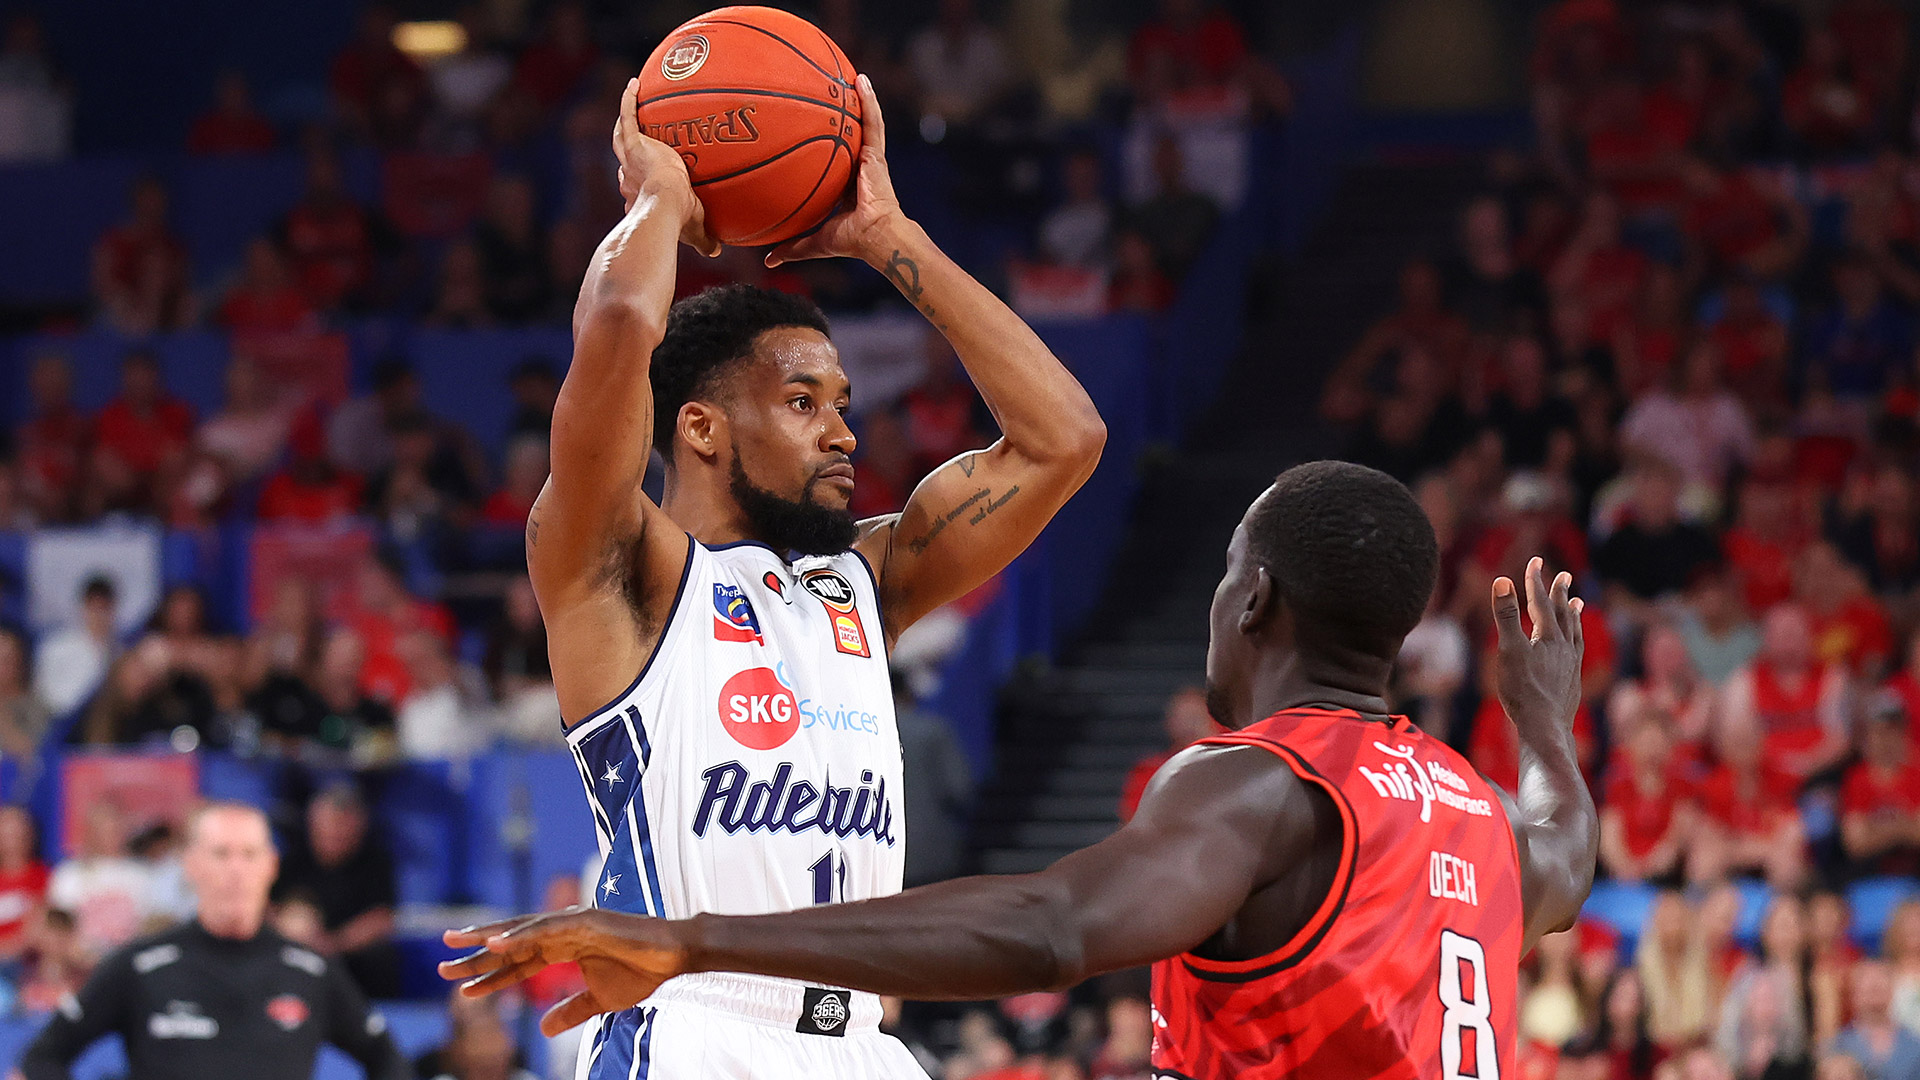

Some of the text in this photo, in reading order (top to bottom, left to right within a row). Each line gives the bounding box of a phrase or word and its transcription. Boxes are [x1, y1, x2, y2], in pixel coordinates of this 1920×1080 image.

[640, 104, 760, 147] SPALDI
[811, 578, 848, 600] NBL
[729, 693, 792, 724] SKG
[1427, 760, 1470, 793] Health
[1433, 782, 1492, 817] Insurance
[1429, 850, 1479, 906] OECH
[814, 1003, 845, 1019] 36ERS
[1438, 928, 1500, 1080] 8
